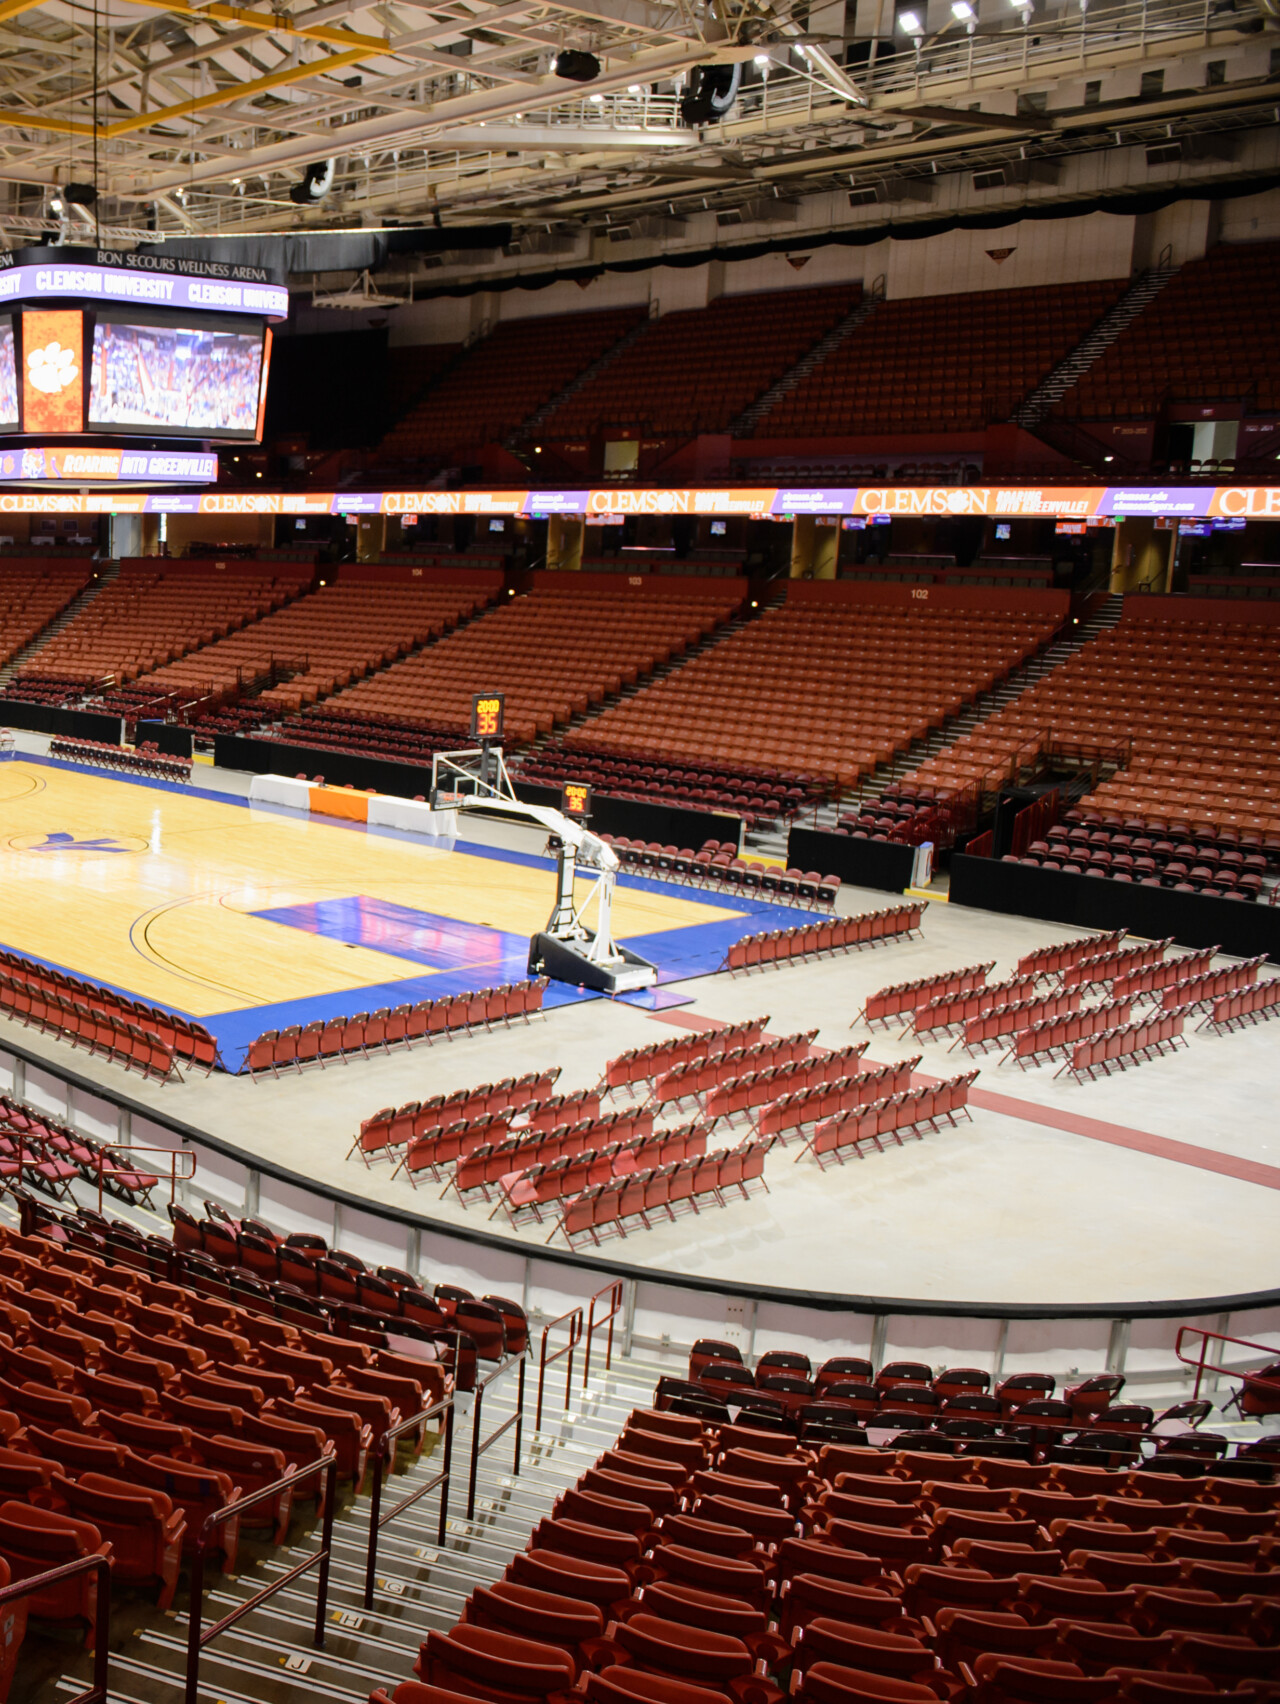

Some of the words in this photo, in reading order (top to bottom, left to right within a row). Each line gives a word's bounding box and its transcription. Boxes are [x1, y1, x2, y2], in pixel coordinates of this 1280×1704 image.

[97, 250, 123, 265] BON
[126, 254, 176, 271] SECOURS
[178, 260, 230, 277] WELLNESS
[232, 266, 267, 281] ARENA
[36, 270, 102, 292] CLEMSON
[104, 274, 174, 300] UNIVERSITY
[188, 283, 242, 306] CLEMSON
[63, 454, 120, 474] ROARING
[120, 456, 148, 474] INTO
[148, 457, 214, 476] GREENVILLE!
[384, 494, 460, 512] CLEMSON
[592, 492, 690, 513] CLEMSON
[861, 490, 990, 513] CLEMSON
[996, 490, 1042, 502] ROARING
[1114, 491, 1168, 501] clemson.edu
[0, 496, 83, 512] CLEMSON
[203, 496, 280, 512] CLEMSON
[996, 501, 1019, 512] INTO
[1022, 501, 1088, 513] GREENVILLE!
[1113, 501, 1195, 513] clemsontigers.com
[412, 568, 422, 577] 104
[628, 576, 642, 586] 103
[910, 588, 928, 600] 102
[478, 700, 500, 713] 20:00
[478, 713, 497, 734] 35
[570, 797, 584, 812] 35
[388, 1582, 402, 1592] G
[344, 1614, 360, 1626] H
[291, 1658, 304, 1670] J
